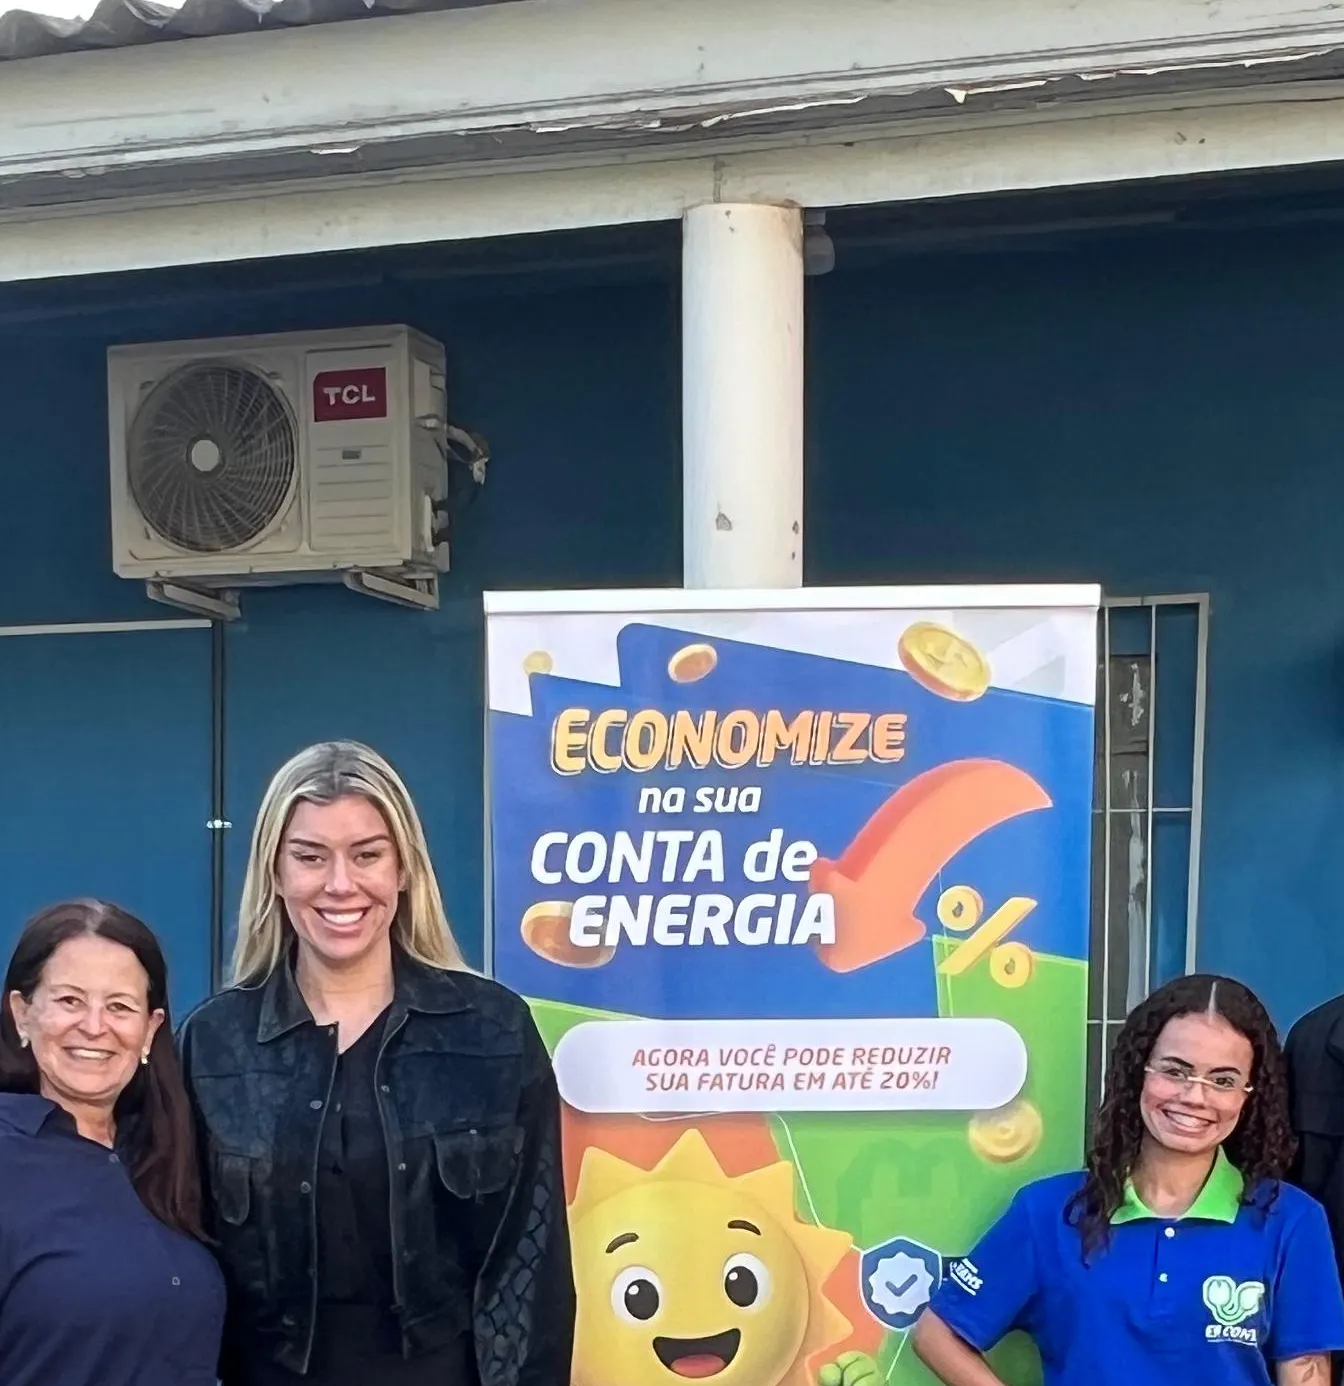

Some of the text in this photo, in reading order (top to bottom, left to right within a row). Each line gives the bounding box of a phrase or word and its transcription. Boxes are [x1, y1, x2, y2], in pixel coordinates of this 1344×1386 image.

[323, 384, 376, 406] TCL
[551, 708, 908, 775] ECONOMIZE
[638, 786, 762, 813] na sua
[530, 827, 818, 885] CONTA de
[569, 892, 836, 946] ENERGIA
[631, 1043, 952, 1068] AGORA VOCÊ PODE REDUZIR
[644, 1066, 940, 1092] SUA FATURA EM ATÉ 20%!
[1223, 1325, 1257, 1342] CONT
